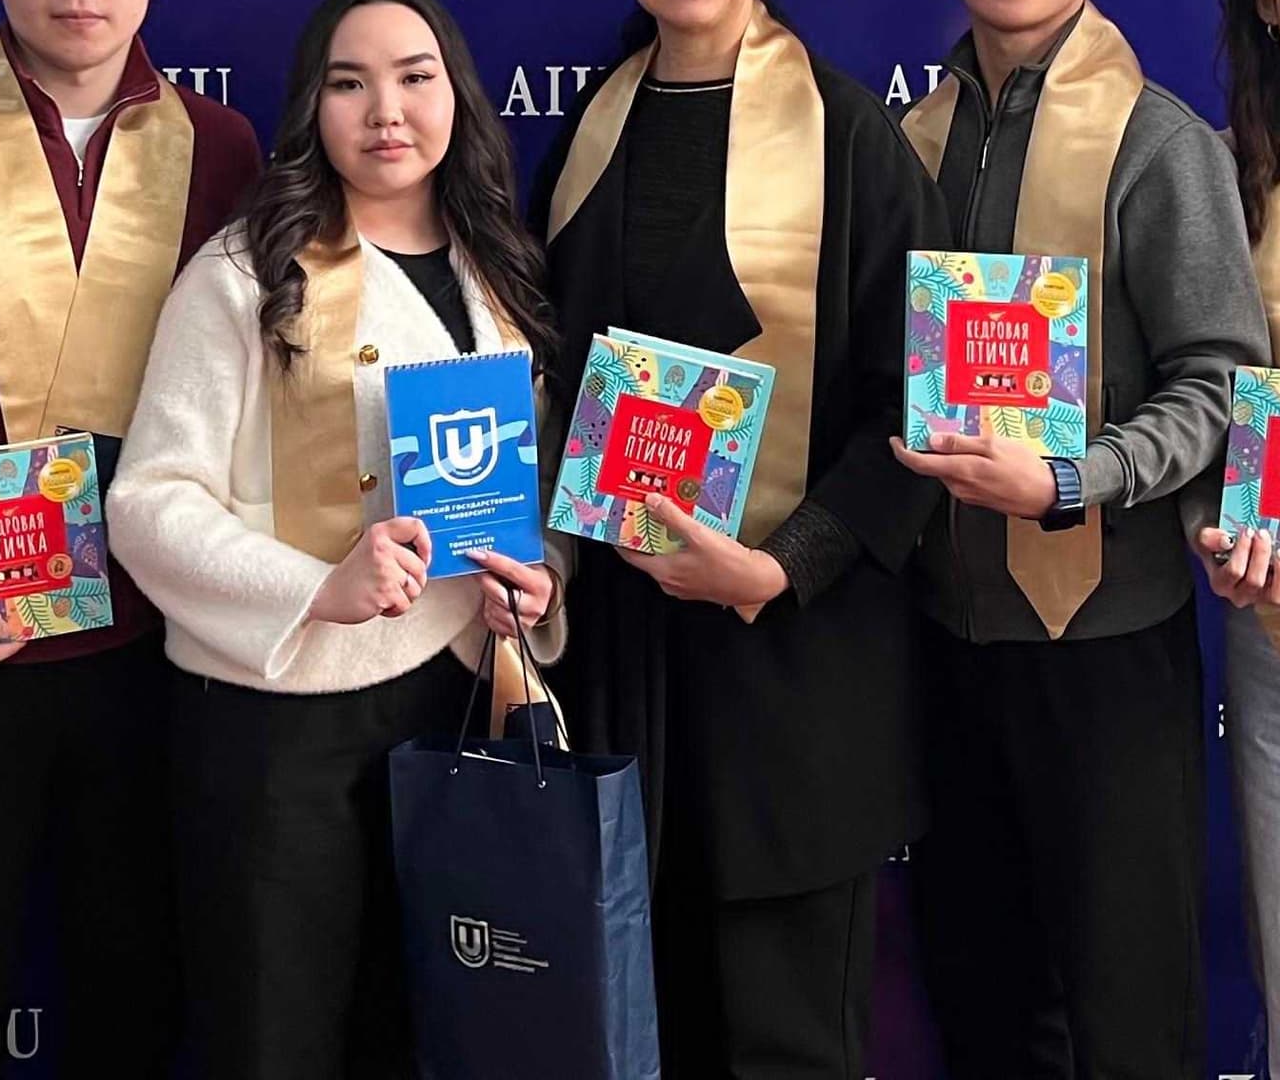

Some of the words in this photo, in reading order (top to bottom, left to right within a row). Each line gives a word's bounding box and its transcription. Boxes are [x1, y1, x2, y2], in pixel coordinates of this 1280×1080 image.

[966, 319, 1029, 340] КЕДРОВАЯ
[966, 340, 1029, 366] ПТИЧКА
[630, 415, 693, 446] КЕДРОВАЯ
[624, 435, 687, 471] ПТИЧКА
